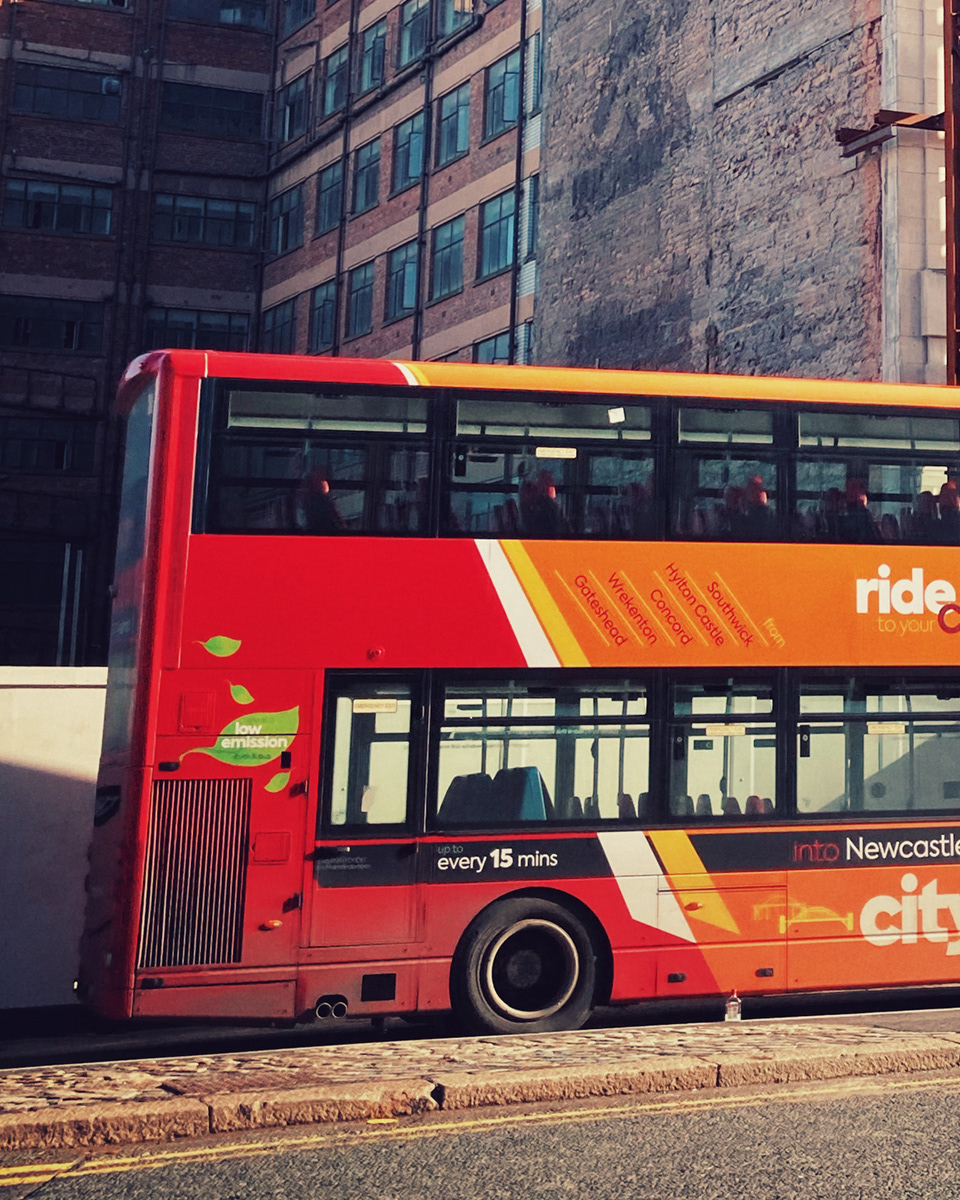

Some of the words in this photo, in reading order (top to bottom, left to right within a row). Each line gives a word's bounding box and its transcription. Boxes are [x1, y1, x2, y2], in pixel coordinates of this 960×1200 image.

[665, 562, 697, 606] Hylton
[694, 604, 724, 646] Castle
[856, 564, 956, 615] ride
[574, 575, 628, 646] Gateshead
[608, 572, 657, 645] Wrekenton
[650, 589, 693, 645] Concord
[707, 581, 754, 647] Southwick
[761, 617, 786, 648] from
[878, 617, 896, 633] to
[900, 618, 936, 637] your
[221, 736, 288, 749] emission
[235, 722, 262, 735] low
[437, 845, 450, 855] up
[453, 845, 463, 854] to
[437, 855, 487, 873] every
[489, 848, 513, 868] 15
[517, 851, 558, 868] mins
[793, 839, 839, 862] into
